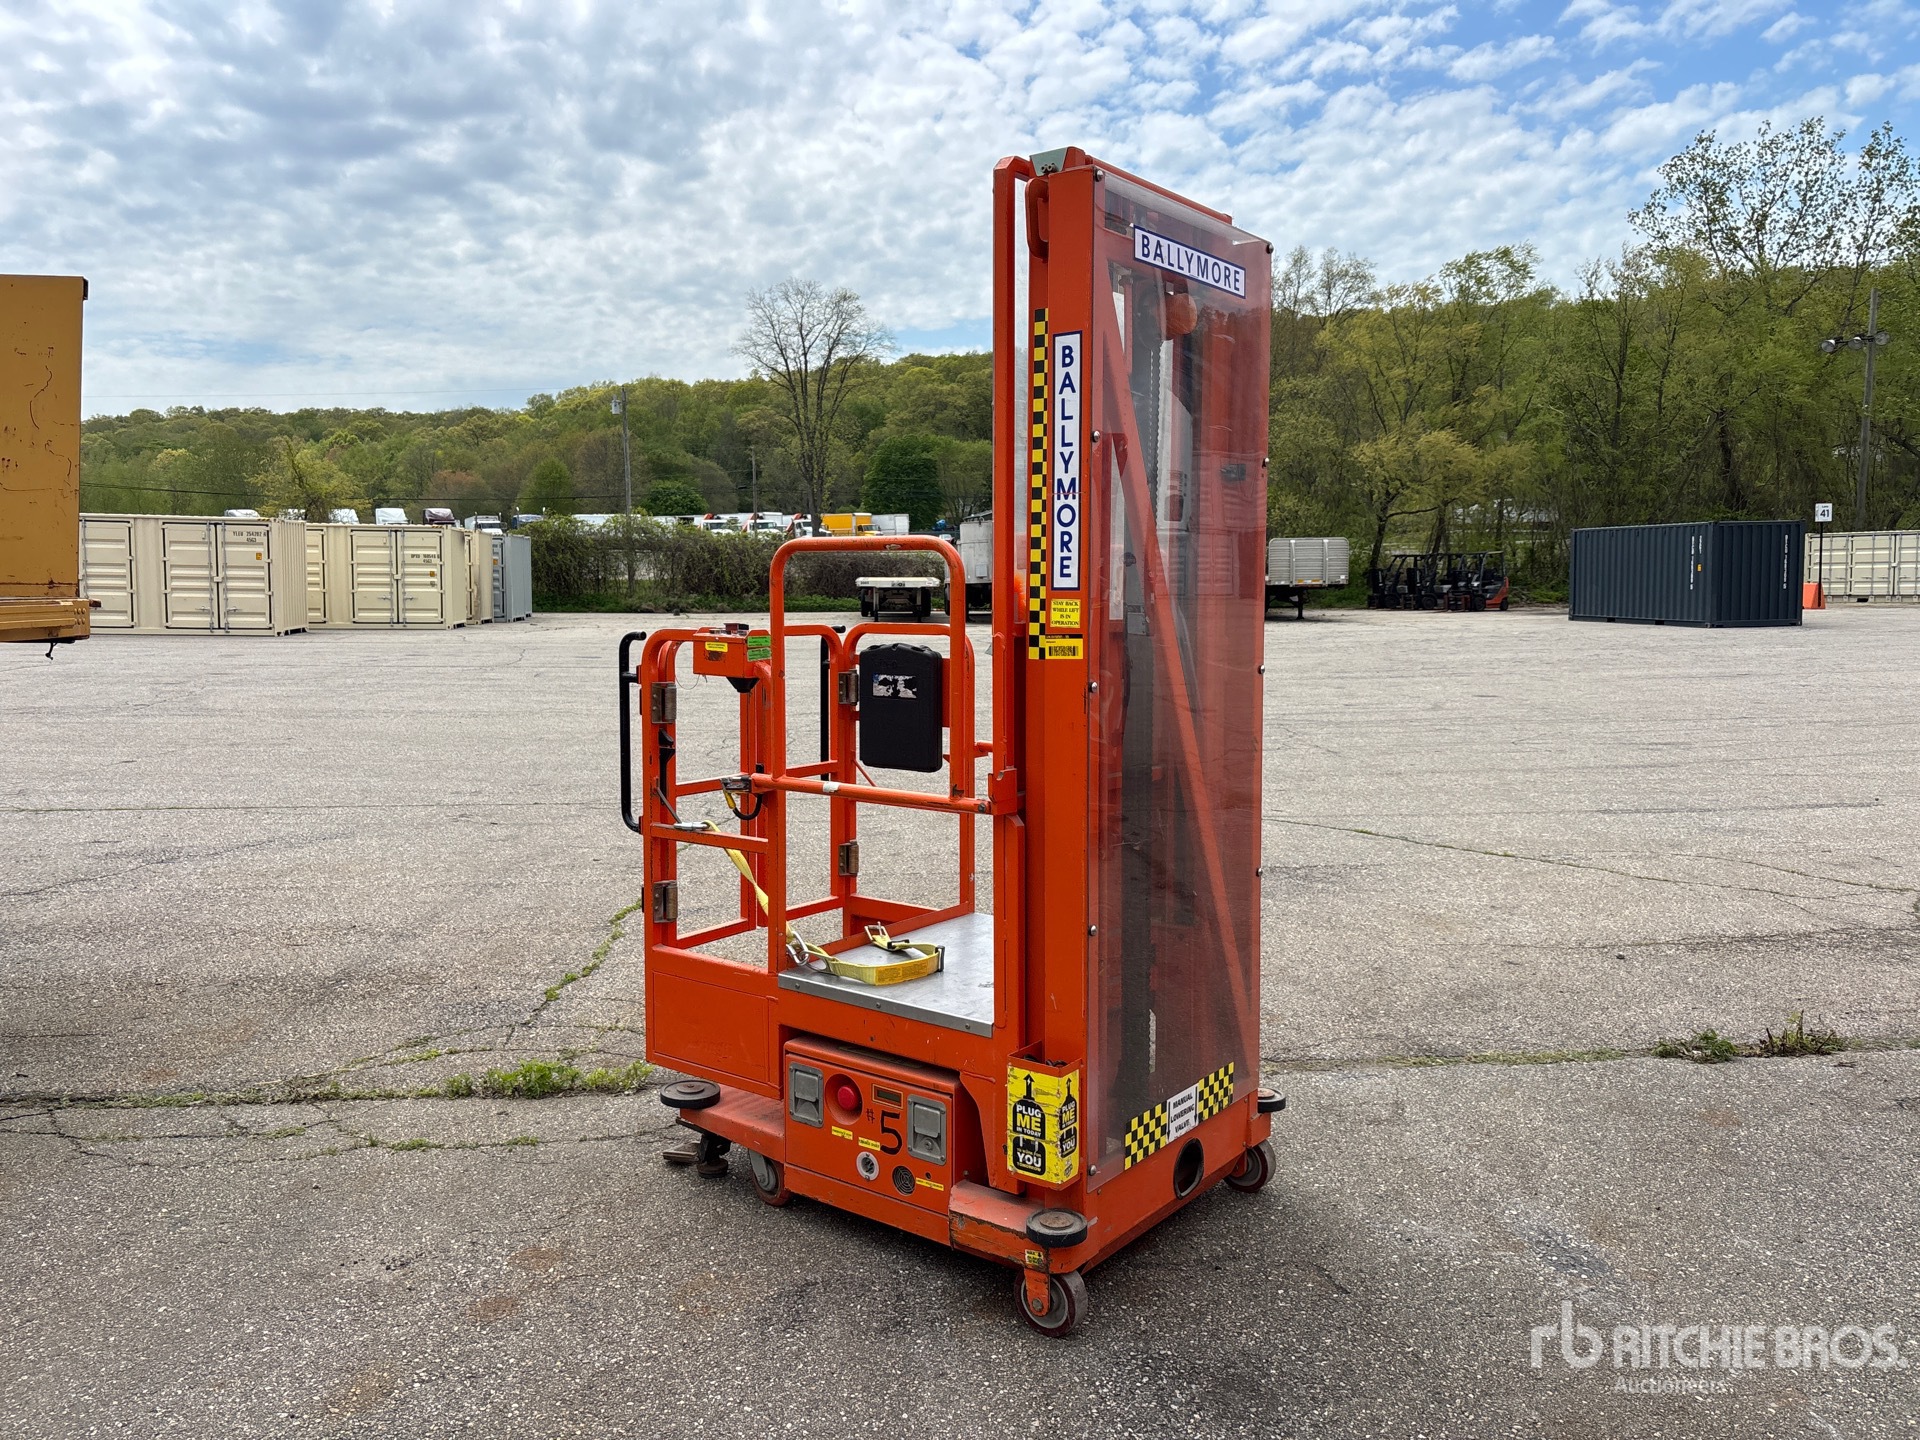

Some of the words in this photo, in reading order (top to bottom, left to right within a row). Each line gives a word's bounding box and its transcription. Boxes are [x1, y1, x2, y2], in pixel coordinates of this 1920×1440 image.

[1141, 233, 1240, 292] BALLYMORE
[1056, 345, 1077, 578] BALLYMORE
[1820, 509, 1830, 518] 41
[1062, 1101, 1076, 1113] PLUG
[1173, 1092, 1193, 1109] MANUAL
[1016, 1104, 1041, 1118] PLUG
[1062, 1108, 1075, 1123] ME
[1170, 1103, 1195, 1123] LOWERING
[1017, 1113, 1041, 1132] ME
[1174, 1119, 1190, 1133] VALVE
[1023, 1128, 1041, 1138] TODAY
[1062, 1138, 1075, 1151] YOU
[1017, 1151, 1042, 1167] YOU
